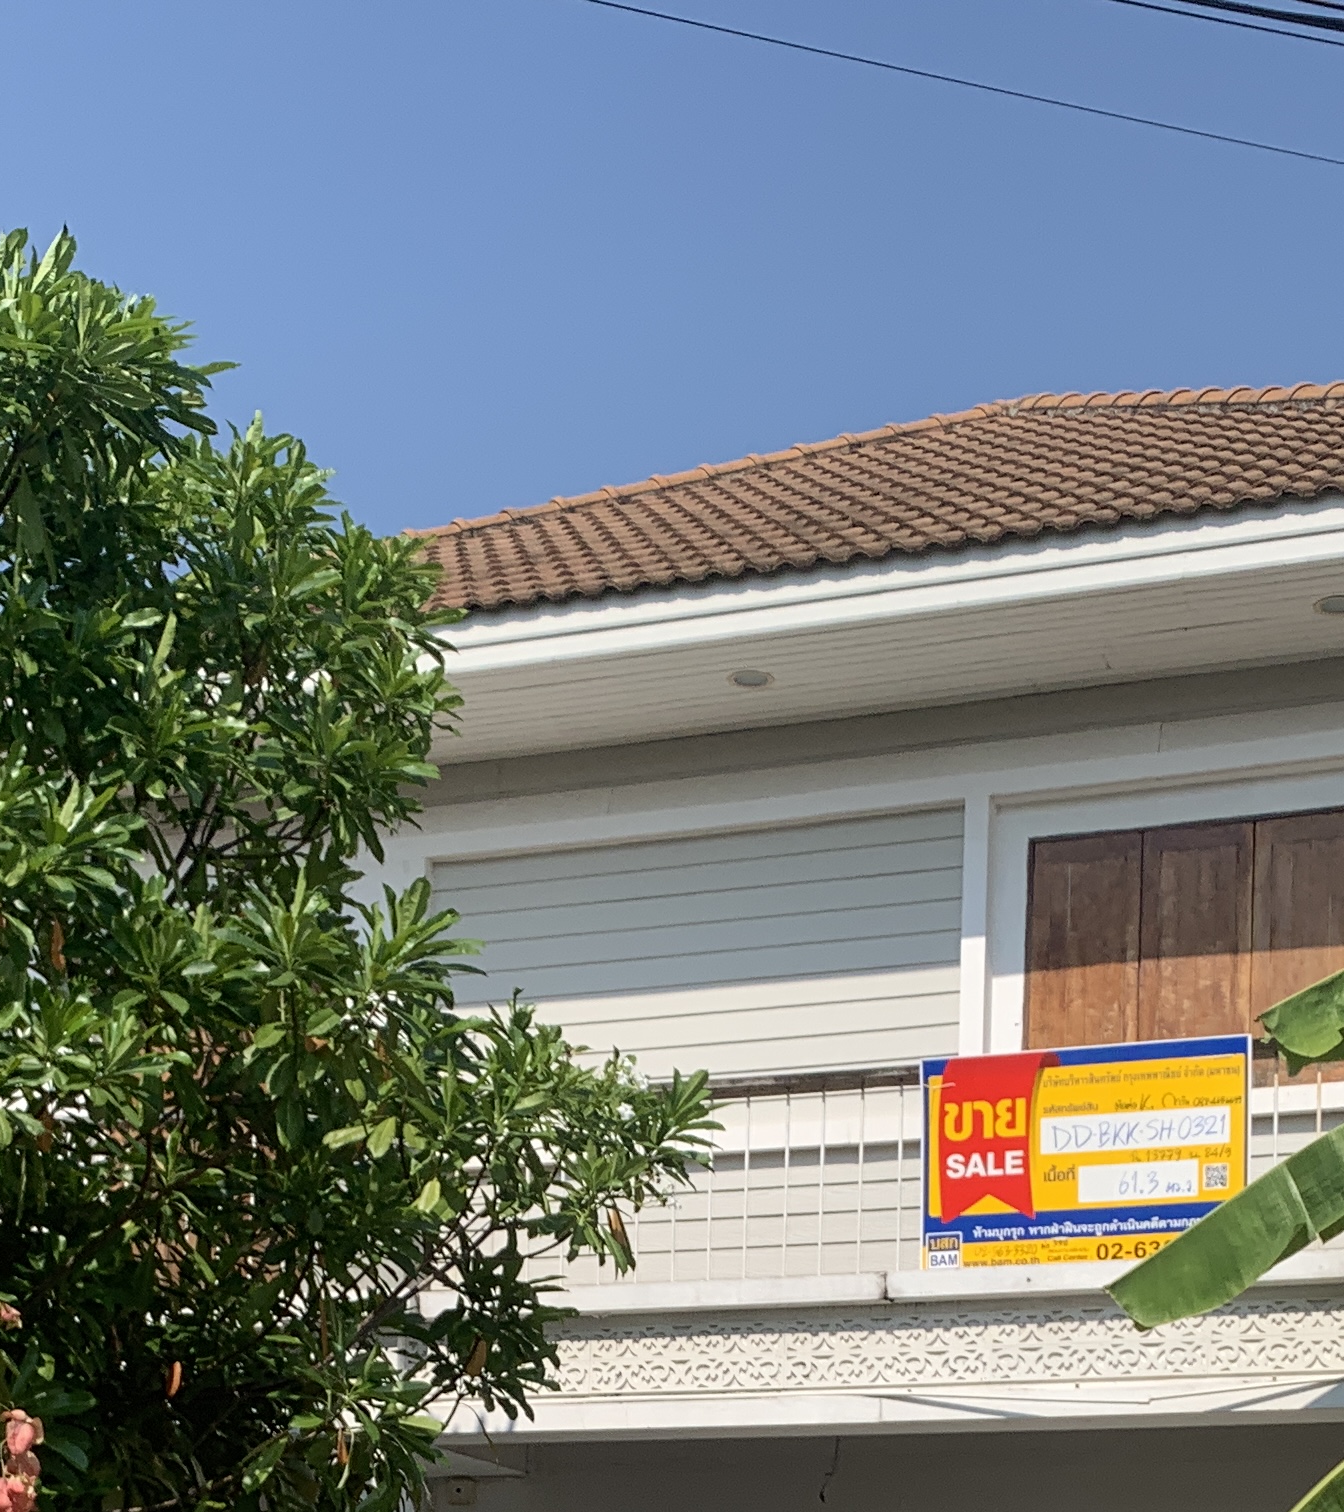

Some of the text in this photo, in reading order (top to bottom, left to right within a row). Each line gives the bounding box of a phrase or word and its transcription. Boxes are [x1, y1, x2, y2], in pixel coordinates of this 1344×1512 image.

[943, 1098, 1026, 1141] ขาย
[945, 1150, 1025, 1179] SALE
[1043, 1164, 1076, 1183] เนื้อที่
[972, 1224, 1025, 1241] ห้ามบุกรุก
[929, 1237, 959, 1250] บสก
[1096, 1240, 1172, 1261] 02-63
[930, 1254, 958, 1268] BAM
[963, 1257, 1041, 1268] www.bam.co.th
